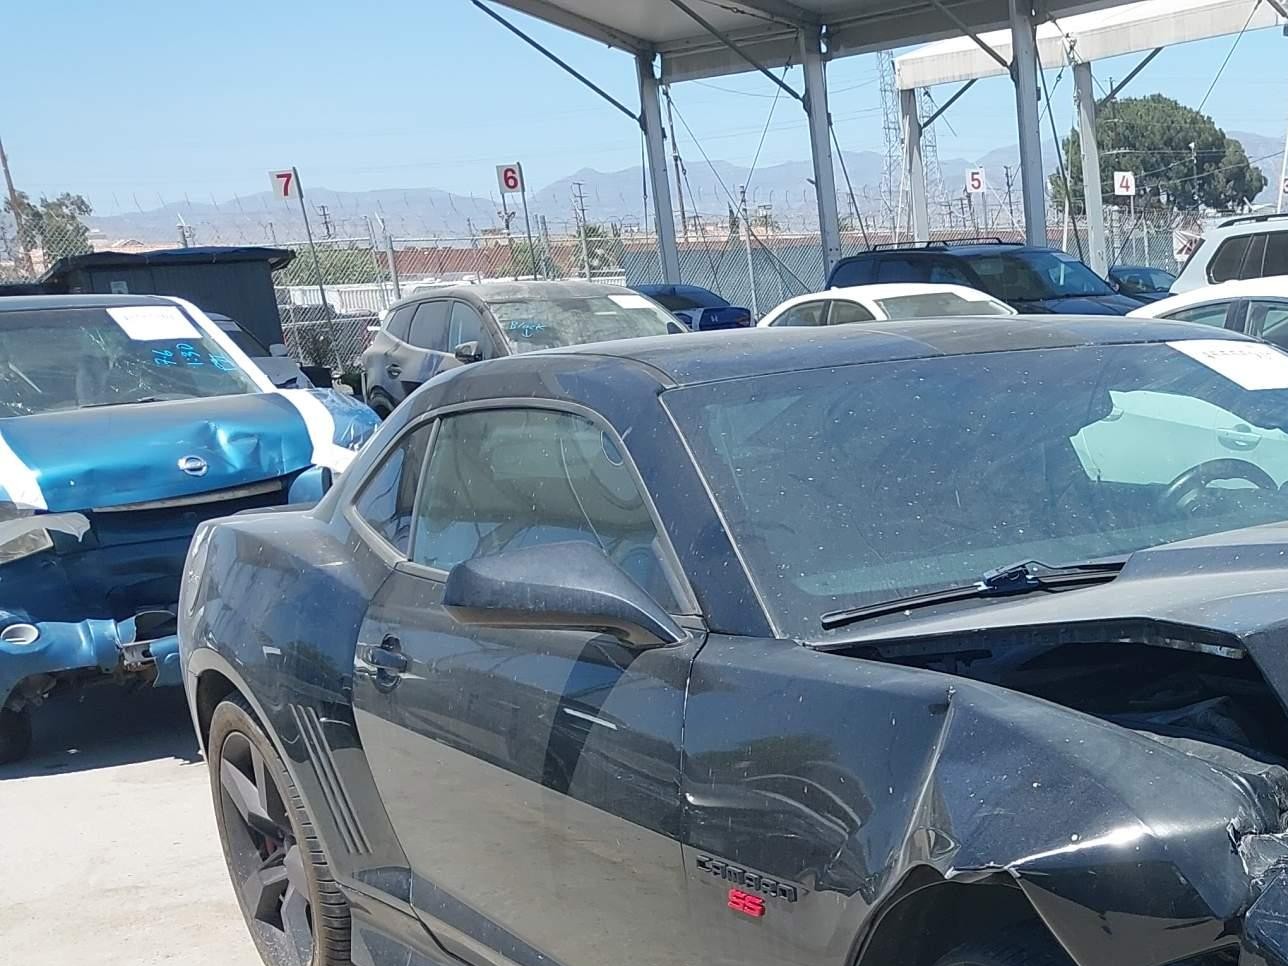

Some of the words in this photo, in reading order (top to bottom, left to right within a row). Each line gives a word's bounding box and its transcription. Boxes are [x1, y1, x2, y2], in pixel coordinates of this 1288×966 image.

[275, 172, 292, 197] 7
[503, 167, 519, 190] 6
[971, 171, 982, 190] 5
[1119, 175, 1131, 193] 4
[696, 854, 798, 903] CAMARO
[727, 888, 766, 918] SS
